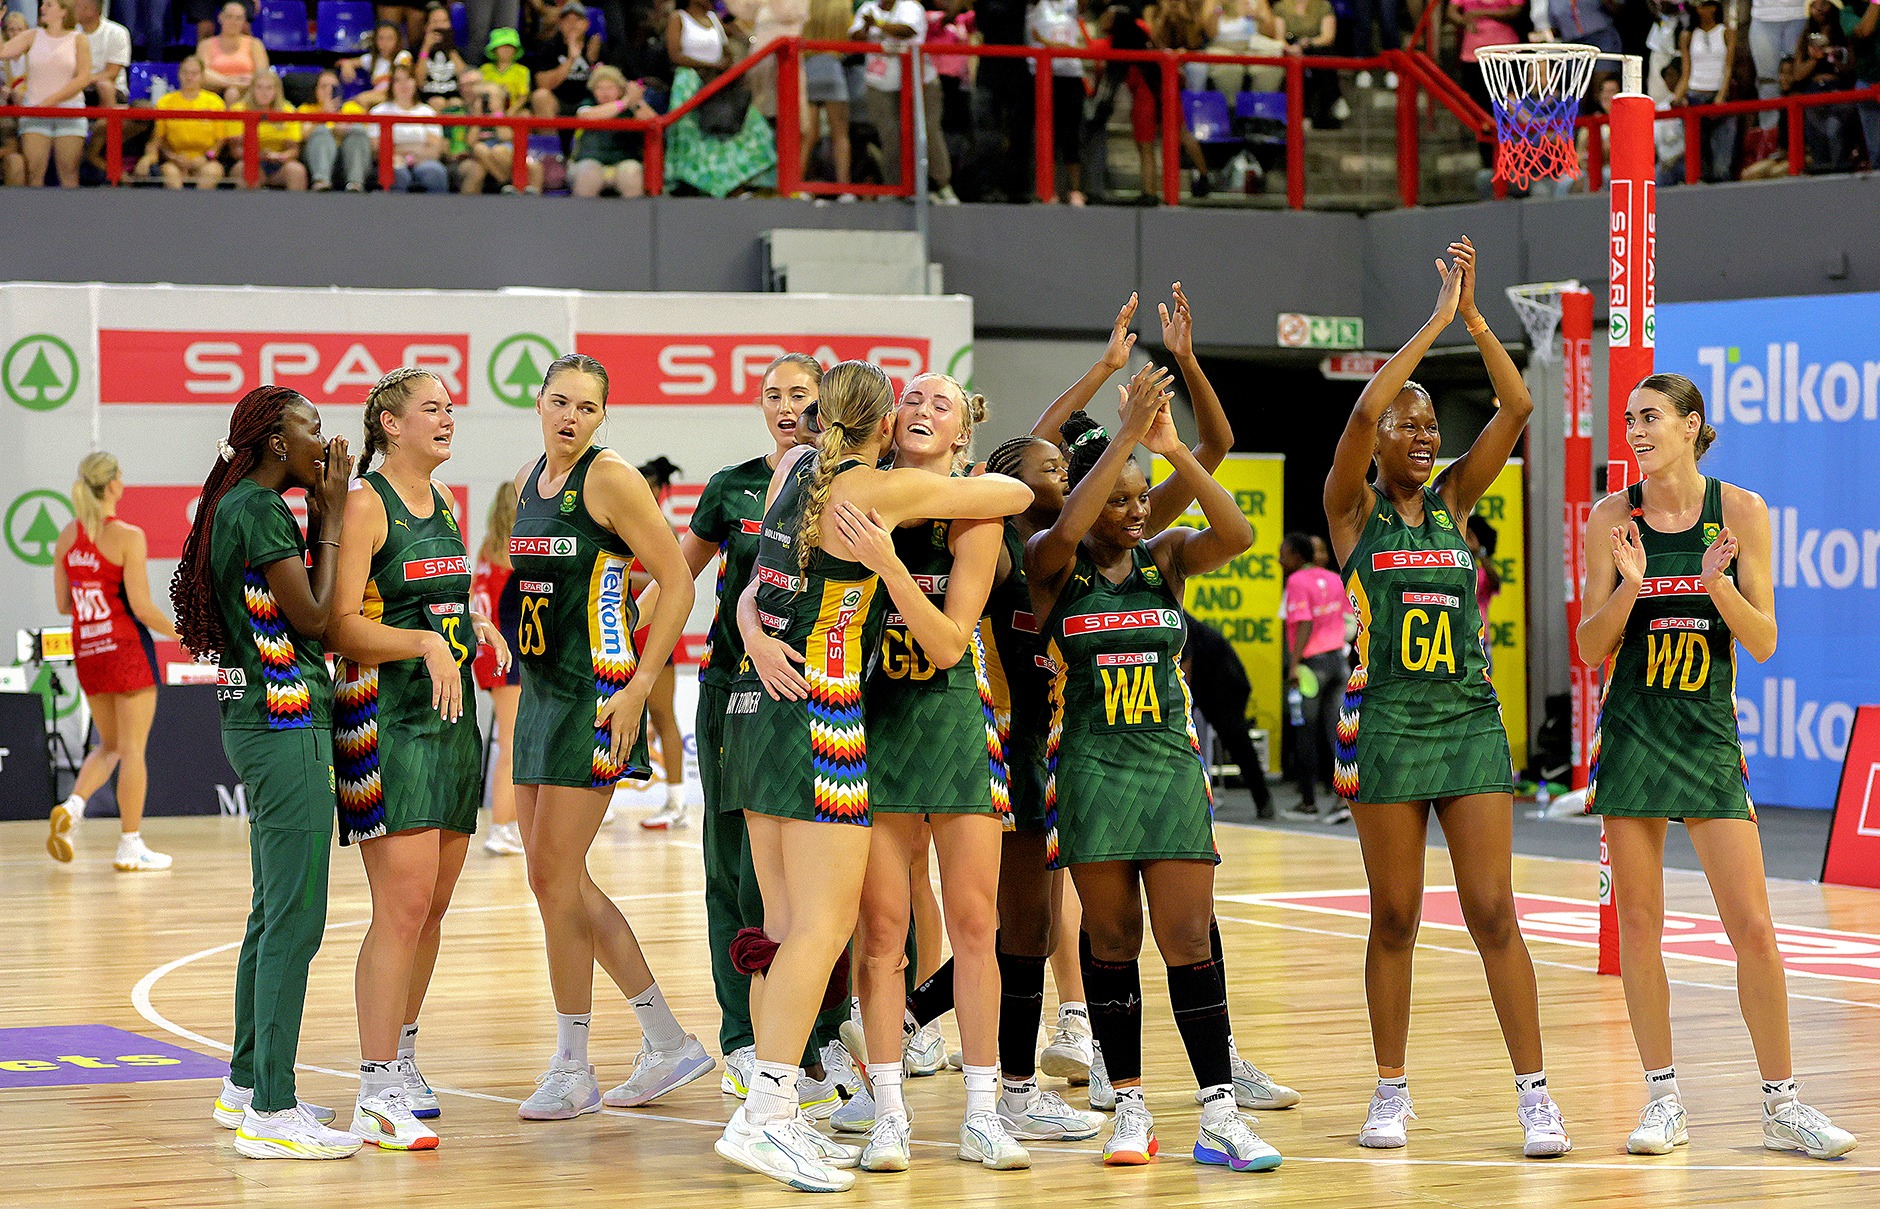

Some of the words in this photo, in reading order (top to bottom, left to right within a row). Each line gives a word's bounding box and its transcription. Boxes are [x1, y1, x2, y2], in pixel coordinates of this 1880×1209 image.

[1611, 211, 1626, 306] SPAR
[184, 342, 463, 395] SPAR
[510, 540, 549, 552] SPAR
[424, 559, 466, 575] SPAR
[1393, 552, 1454, 566] SPAR
[523, 582, 542, 591] SPAR
[760, 568, 789, 587] SPAR
[72, 587, 112, 621] WD
[601, 563, 628, 655] Telkom
[1193, 586, 1242, 612] AND
[1413, 594, 1446, 604] SPAR
[518, 595, 549, 656] GS
[760, 614, 780, 627] SPAR
[1084, 612, 1159, 629] SPAR
[1660, 619, 1695, 627] SPAR
[829, 611, 856, 660] SPAR
[1401, 608, 1456, 674] GA
[882, 629, 937, 681] GD
[1108, 654, 1144, 663] SPAR
[1646, 632, 1711, 692] WD
[1100, 665, 1162, 726] WA
[1003, 1084, 1030, 1094] PUMA
